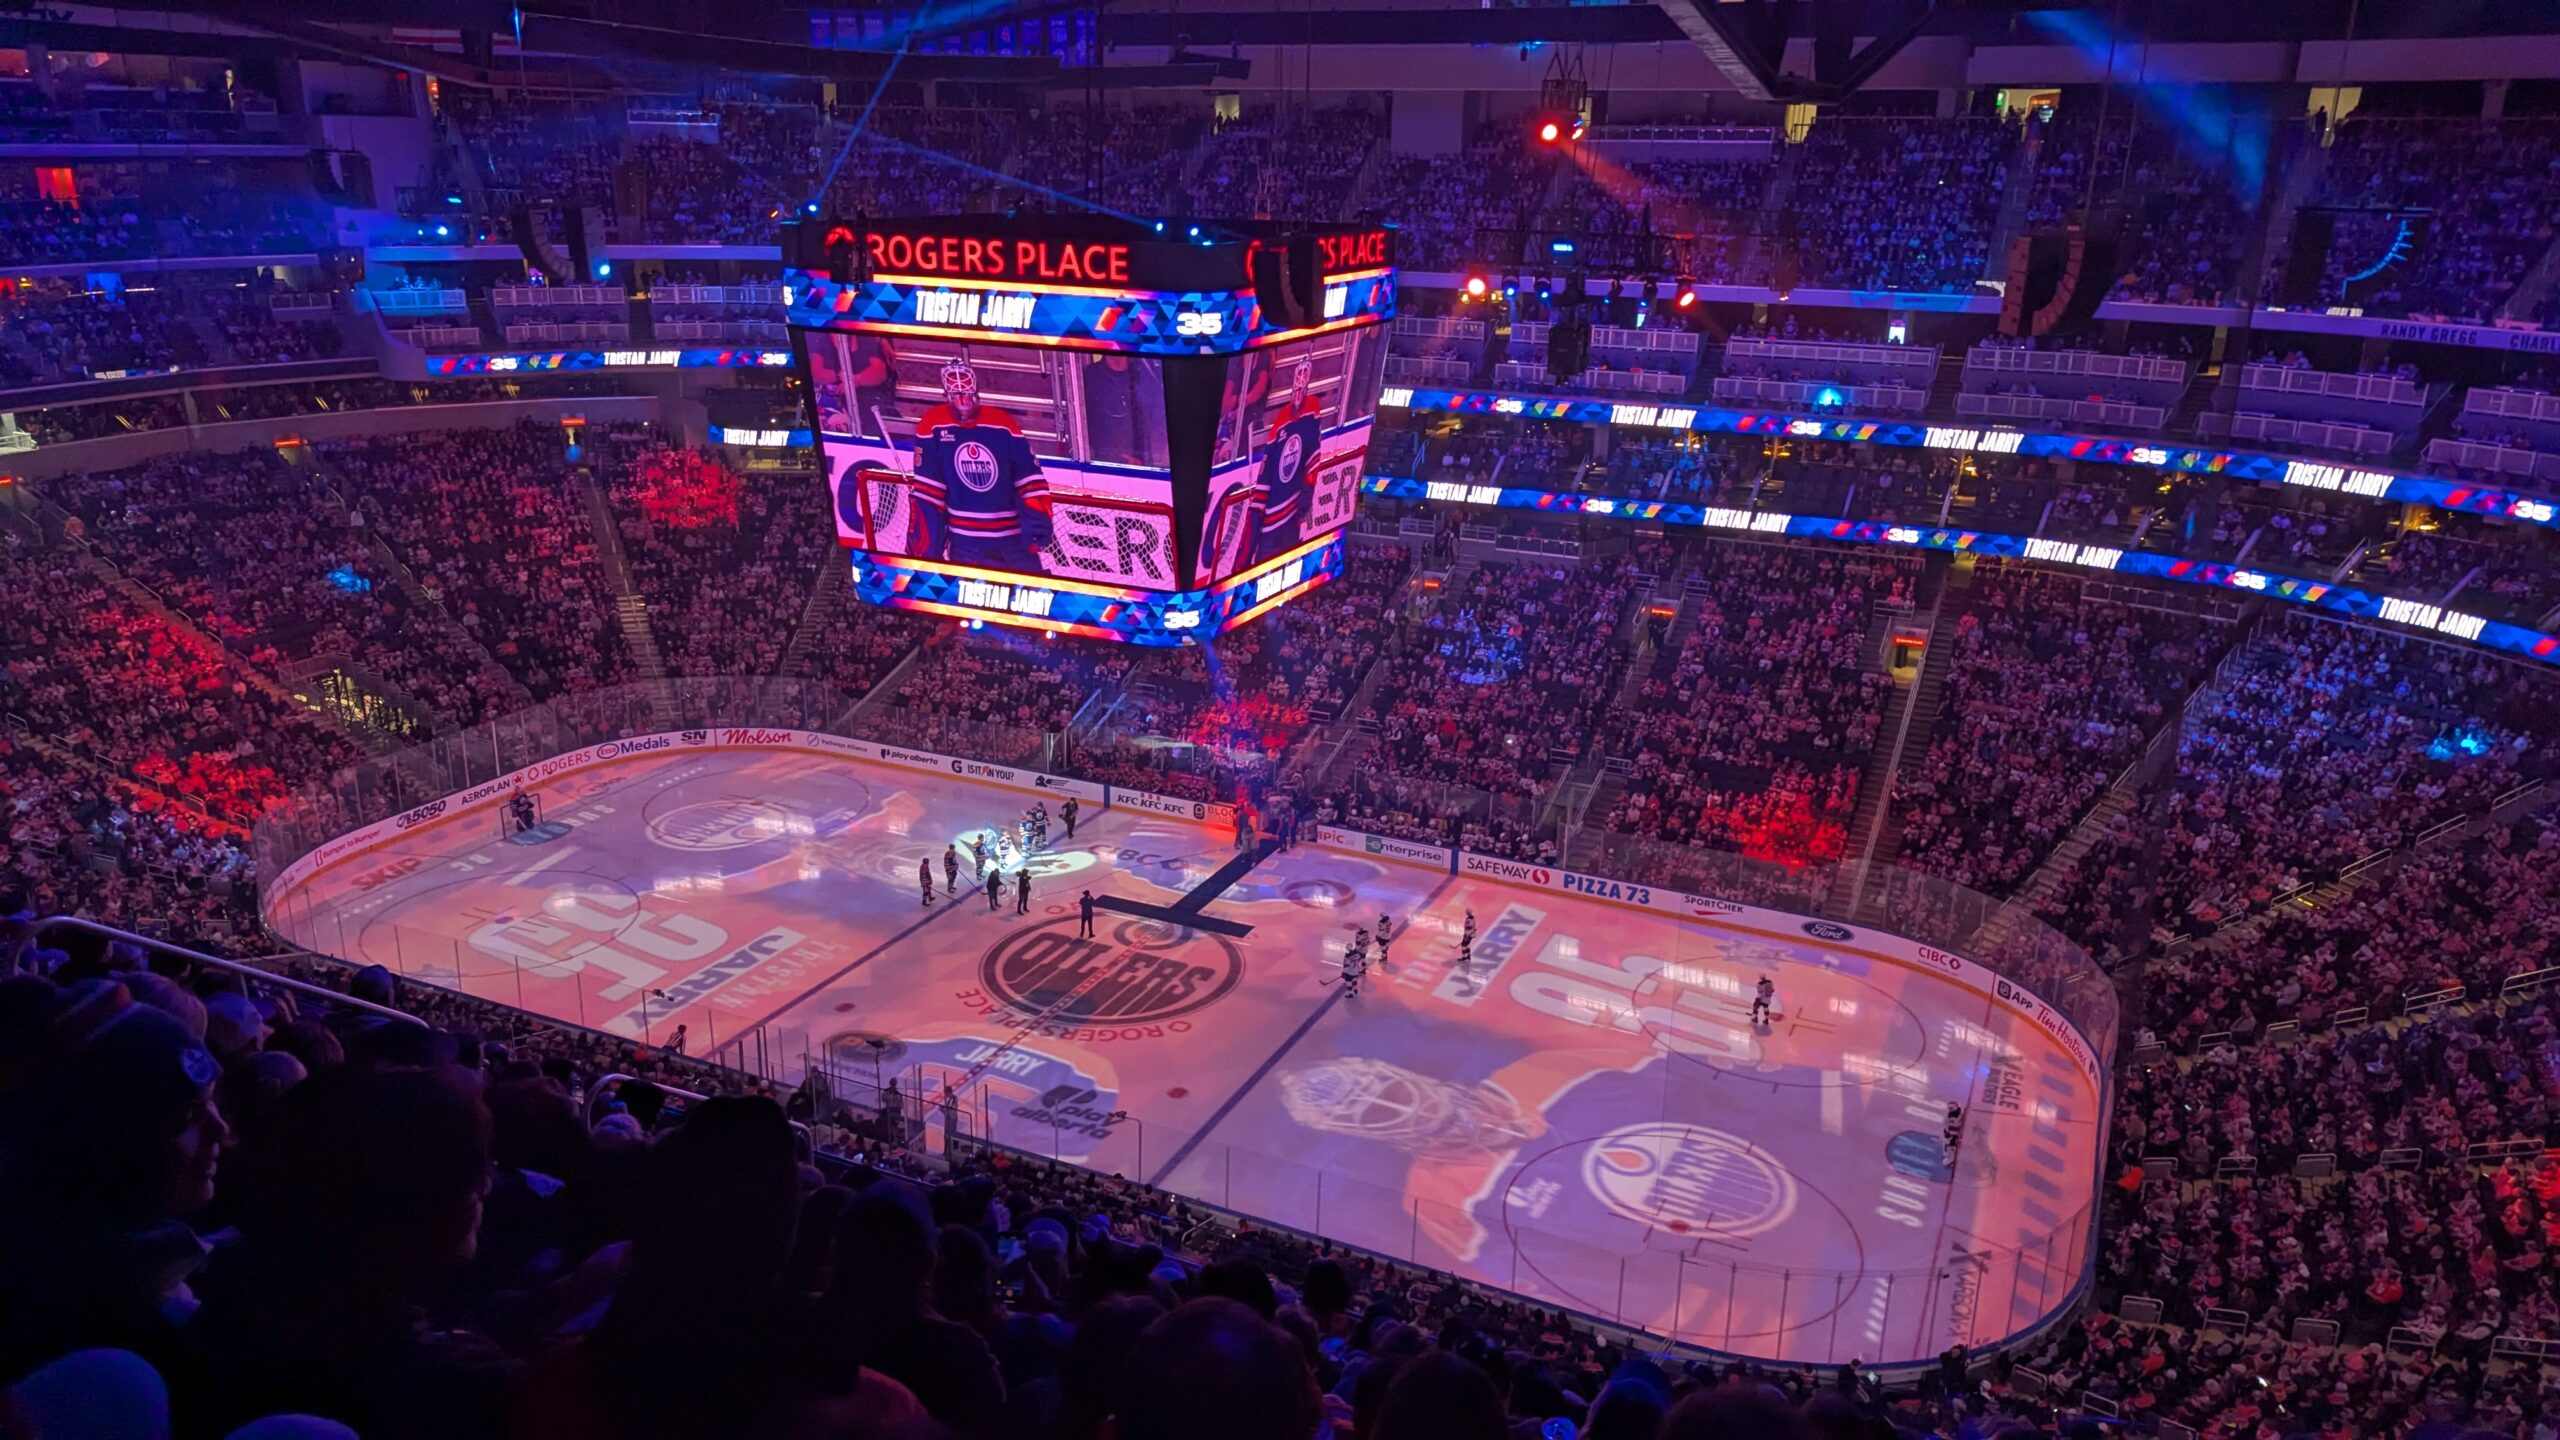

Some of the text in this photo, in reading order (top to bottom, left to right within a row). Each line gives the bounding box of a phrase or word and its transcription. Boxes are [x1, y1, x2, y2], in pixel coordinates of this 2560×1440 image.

[867, 234, 1129, 282] ROGERS PLACE
[1340, 232, 1386, 264] PLACE
[783, 286, 794, 306] 5
[915, 291, 1037, 329] TRISTAN JARRY
[1176, 312, 1222, 335] 35
[2381, 323, 2478, 344] RANDY GREGG
[490, 357, 517, 370] 35
[603, 351, 681, 367] TRISTAN JARRY
[761, 352, 788, 365] 35
[1379, 388, 1414, 408] JARRY
[1495, 399, 1523, 414] 35
[1610, 405, 1698, 429] TRISTAN JARRY
[723, 428, 790, 447] TRISTAN JARRY
[1790, 420, 1822, 436] 35
[1923, 427, 2024, 454] TRISTAN JARRY
[2132, 448, 2167, 465] 35
[2283, 461, 2395, 498] TRISTAN JARRY
[1426, 481, 1503, 505] TRISTAN JARRY
[1586, 499, 1614, 514] 35
[2514, 500, 2552, 521] 35
[1703, 507, 1792, 534] TRISTAN JARRY
[1887, 528, 1919, 543] 35
[2023, 538, 2123, 570] TRISTAN JARRY
[852, 565, 861, 583] 5
[2232, 571, 2266, 590] 35
[957, 580, 1055, 617] TRISTAN JARRY
[1164, 610, 1200, 629] 35
[2377, 596, 2487, 641] TRISTAN JARRY
[620, 735, 671, 755] Medals
[681, 730, 708, 742] SN
[722, 728, 793, 745] Molson
[541, 750, 591, 777] ROGERS
[890, 751, 939, 766] play alberta
[951, 760, 963, 774] G
[995, 768, 1015, 782] YOU?
[461, 779, 511, 806] AEROPLAN
[1117, 794, 1185, 815] KFC KFC KFC
[1207, 805, 1236, 818] BLOC
[323, 842, 347, 859] Bumper
[354, 830, 381, 847] Bumper
[1370, 840, 1442, 861] enterprise
[1466, 858, 1531, 881] SAFEWAY
[1563, 873, 1650, 905] PIZZA 73
[1810, 923, 1844, 940] Ford
[1454, 908, 1538, 998] JARRY
[1918, 946, 1949, 966] CIBC
[624, 933, 785, 1032] JARRY
[1002, 931, 1216, 1018] OILERS
[955, 987, 1165, 1042] ROGERS PLACE
[2036, 1003, 2087, 1066] Tim Hortons
[955, 1045, 1048, 1077] JARRY
[1999, 1067, 2023, 1110] EAGLE
[1010, 1103, 1124, 1140] play alberta
